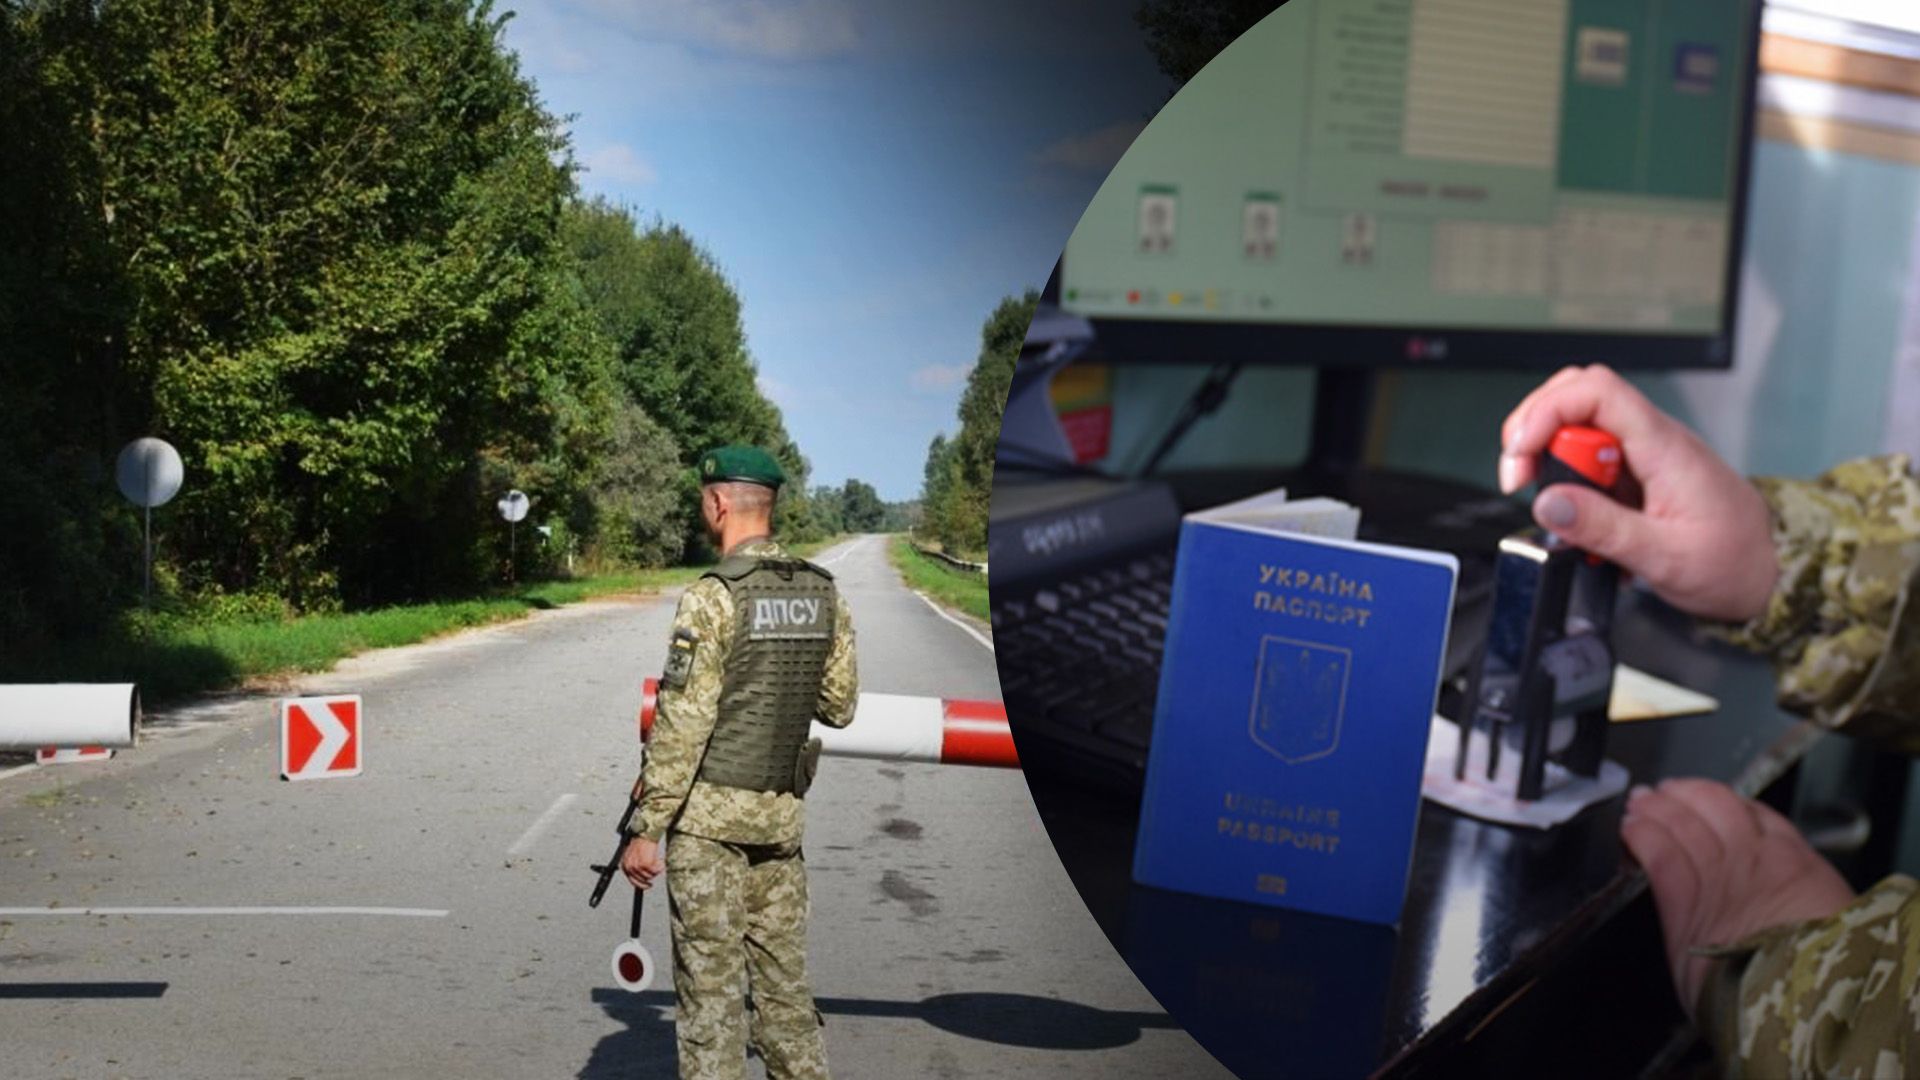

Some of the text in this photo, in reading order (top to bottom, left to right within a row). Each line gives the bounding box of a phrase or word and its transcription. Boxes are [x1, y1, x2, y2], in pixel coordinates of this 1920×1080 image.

[1259, 563, 1374, 601] УКРАЇНА
[754, 598, 820, 630] ДПСУ
[1254, 591, 1371, 628] ПАСПОРТ
